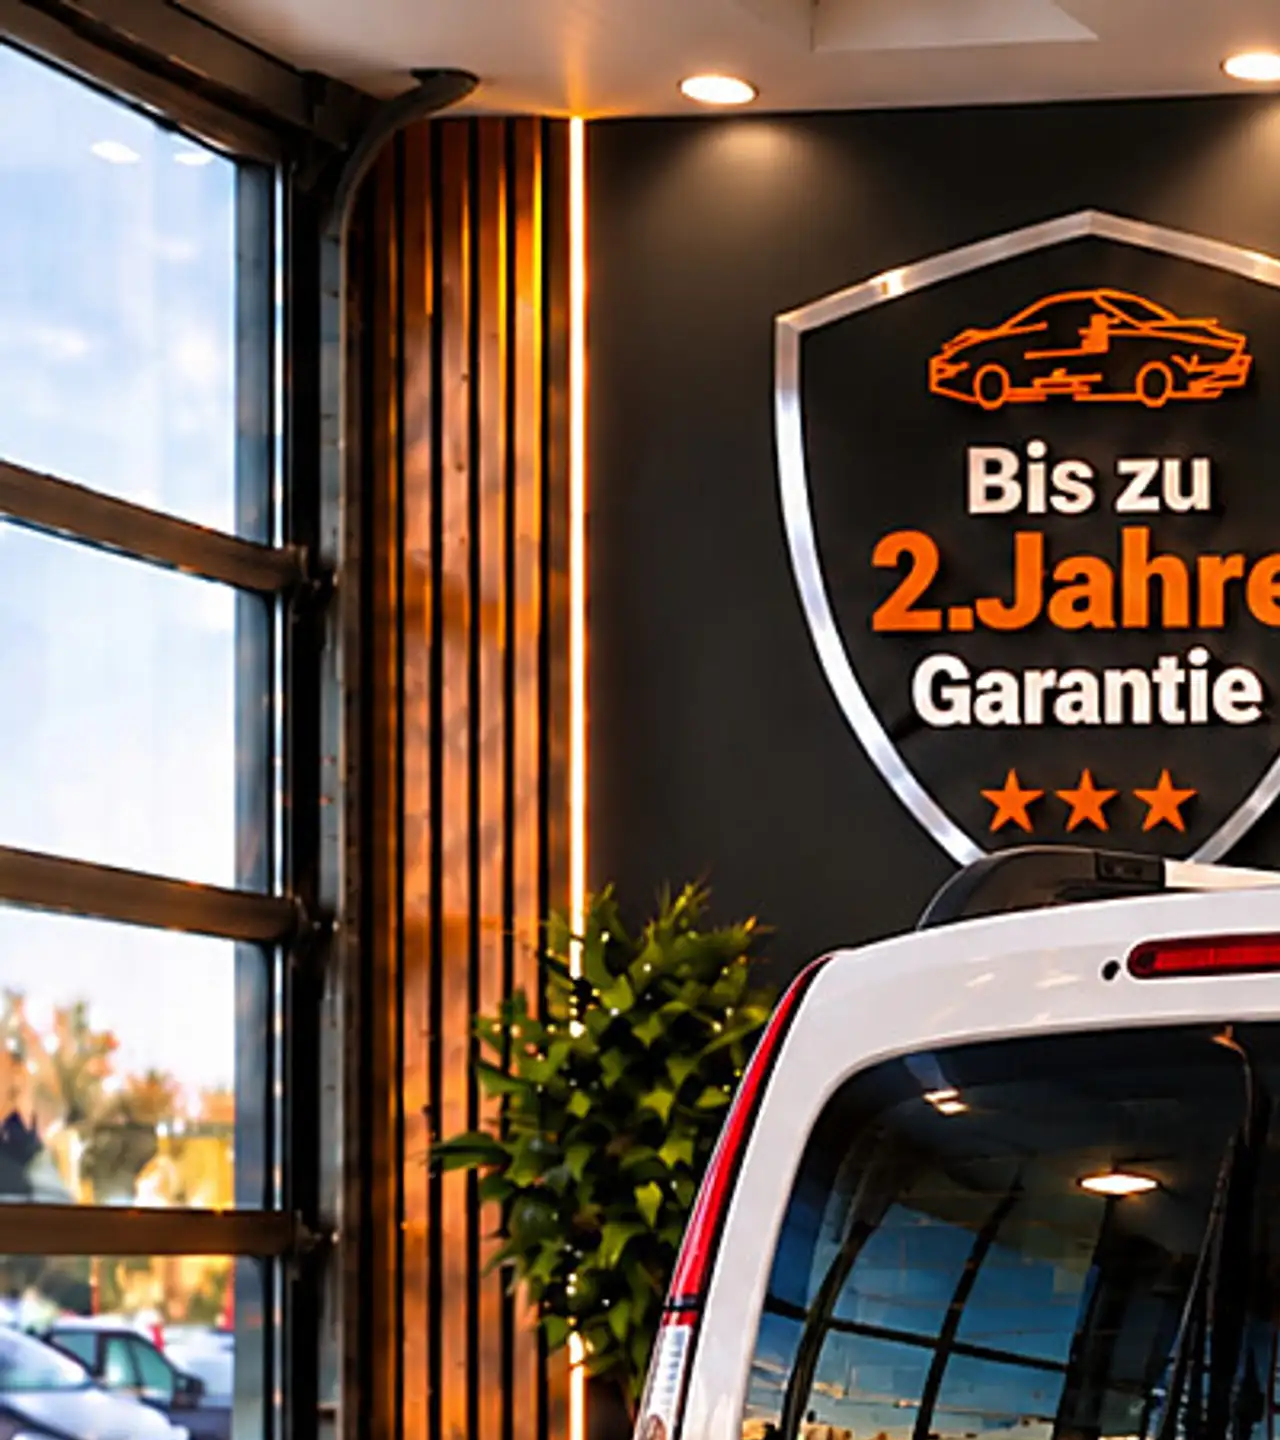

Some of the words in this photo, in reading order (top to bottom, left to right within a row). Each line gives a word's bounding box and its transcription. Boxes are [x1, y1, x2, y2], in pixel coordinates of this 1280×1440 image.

[967, 440, 1095, 514] Bis
[1115, 457, 1211, 511] zu
[912, 646, 1264, 727] Garantie
